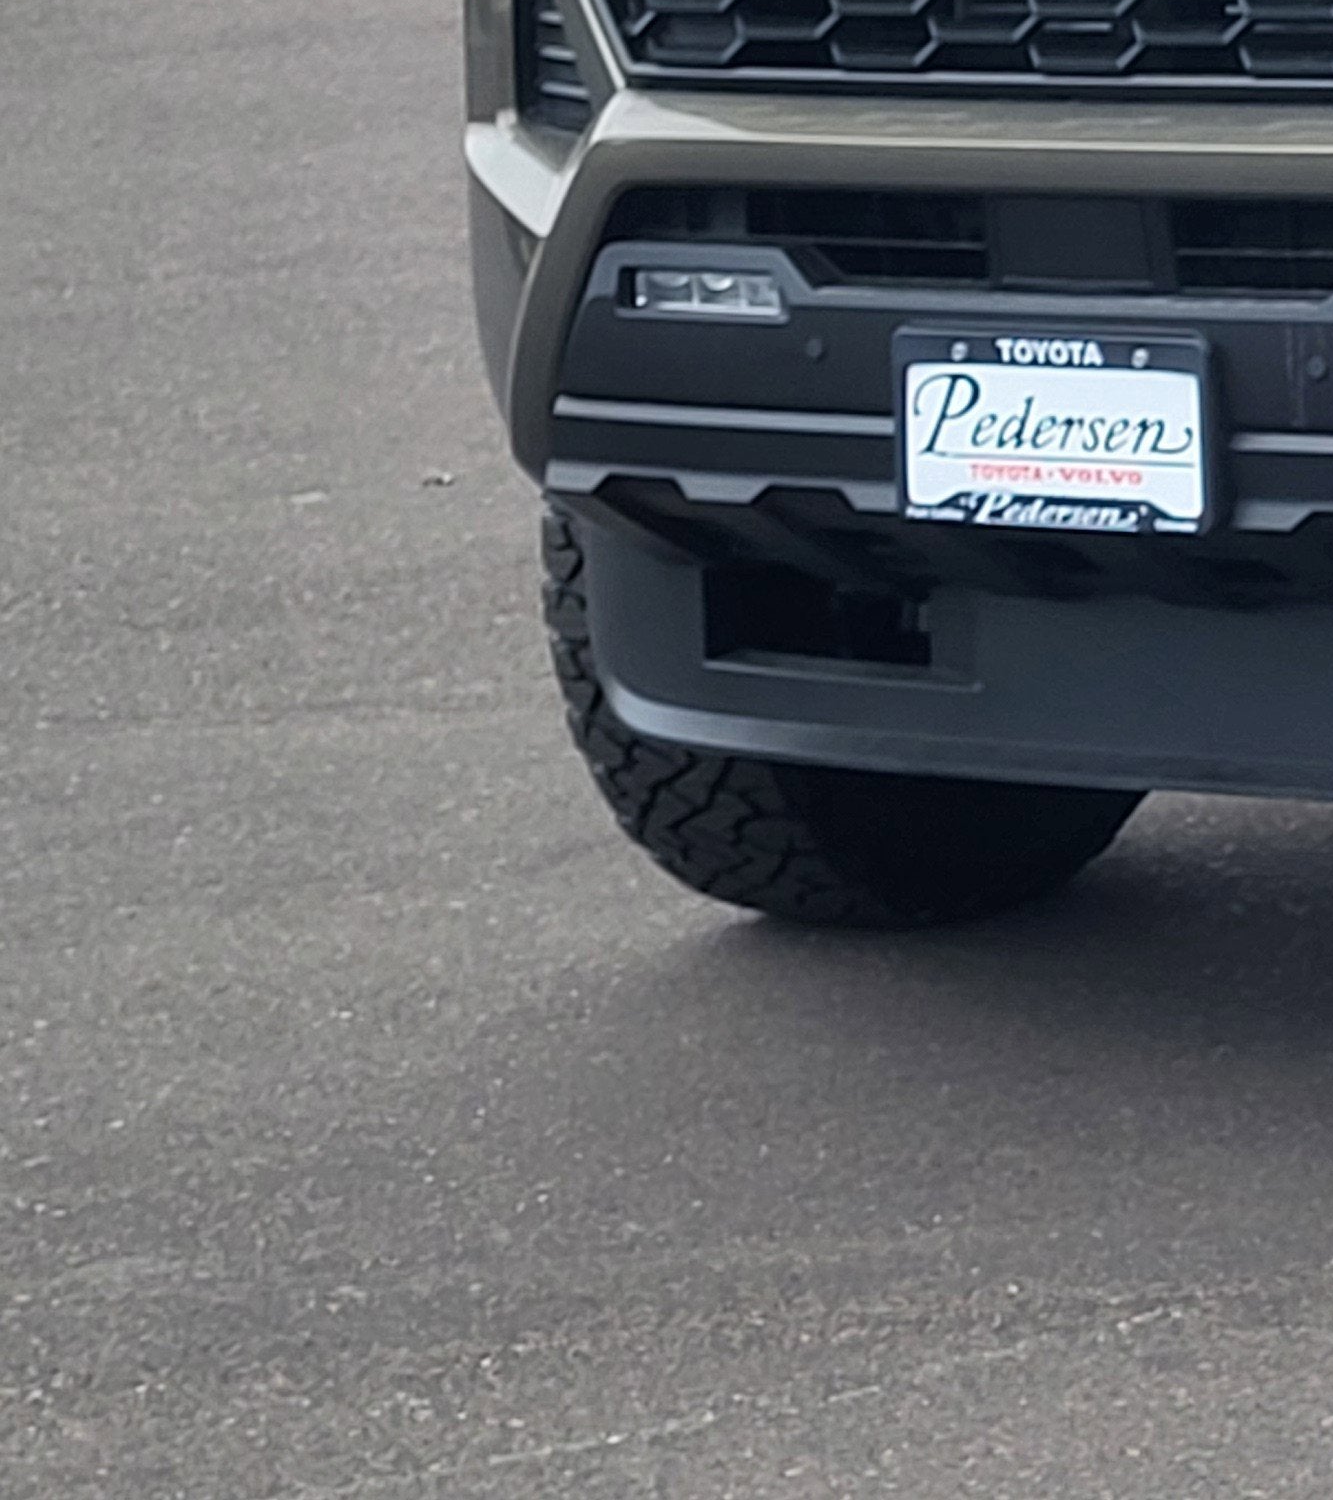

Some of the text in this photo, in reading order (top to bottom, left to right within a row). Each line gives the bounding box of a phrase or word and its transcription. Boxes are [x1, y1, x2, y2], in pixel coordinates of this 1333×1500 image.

[996, 338, 1104, 367] TOYOTA
[913, 372, 1193, 457] Pedersen
[970, 463, 1143, 487] TOYOTA VOLVO
[967, 490, 1140, 534] Pedersen
